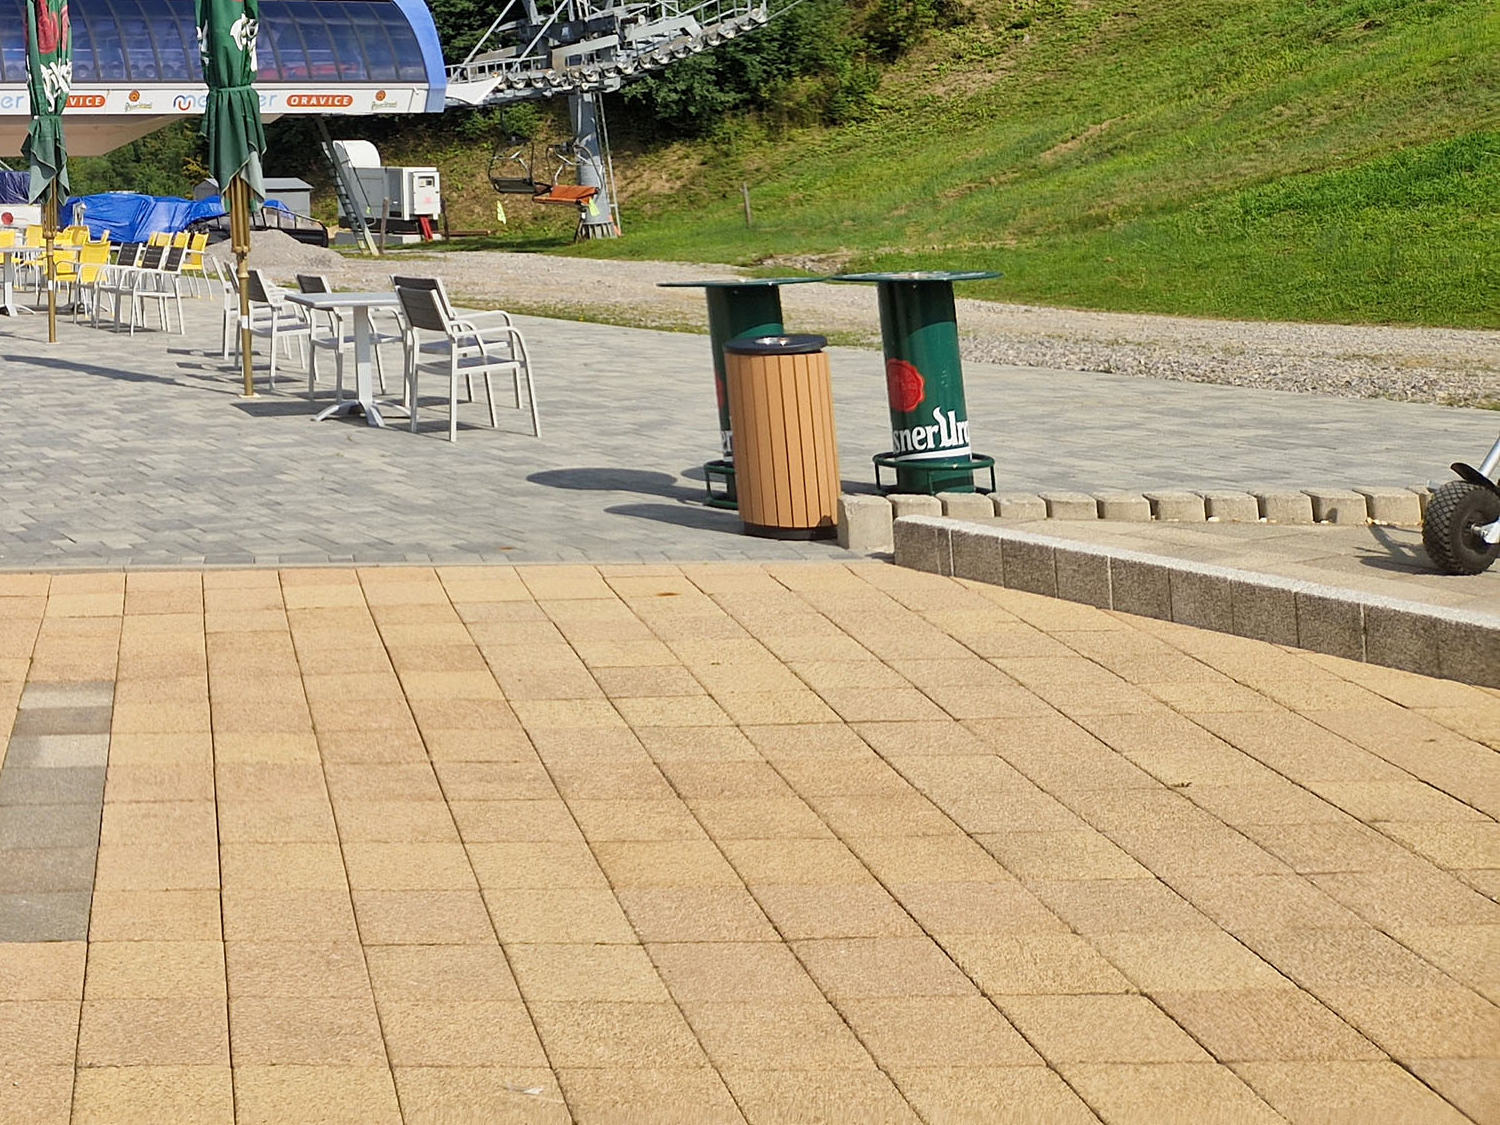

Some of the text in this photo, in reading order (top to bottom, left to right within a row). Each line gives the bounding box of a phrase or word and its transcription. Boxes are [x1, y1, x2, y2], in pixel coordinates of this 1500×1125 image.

[69, 96, 102, 106] VICE
[290, 96, 350, 106] ORAVICE
[893, 424, 940, 455] sner
